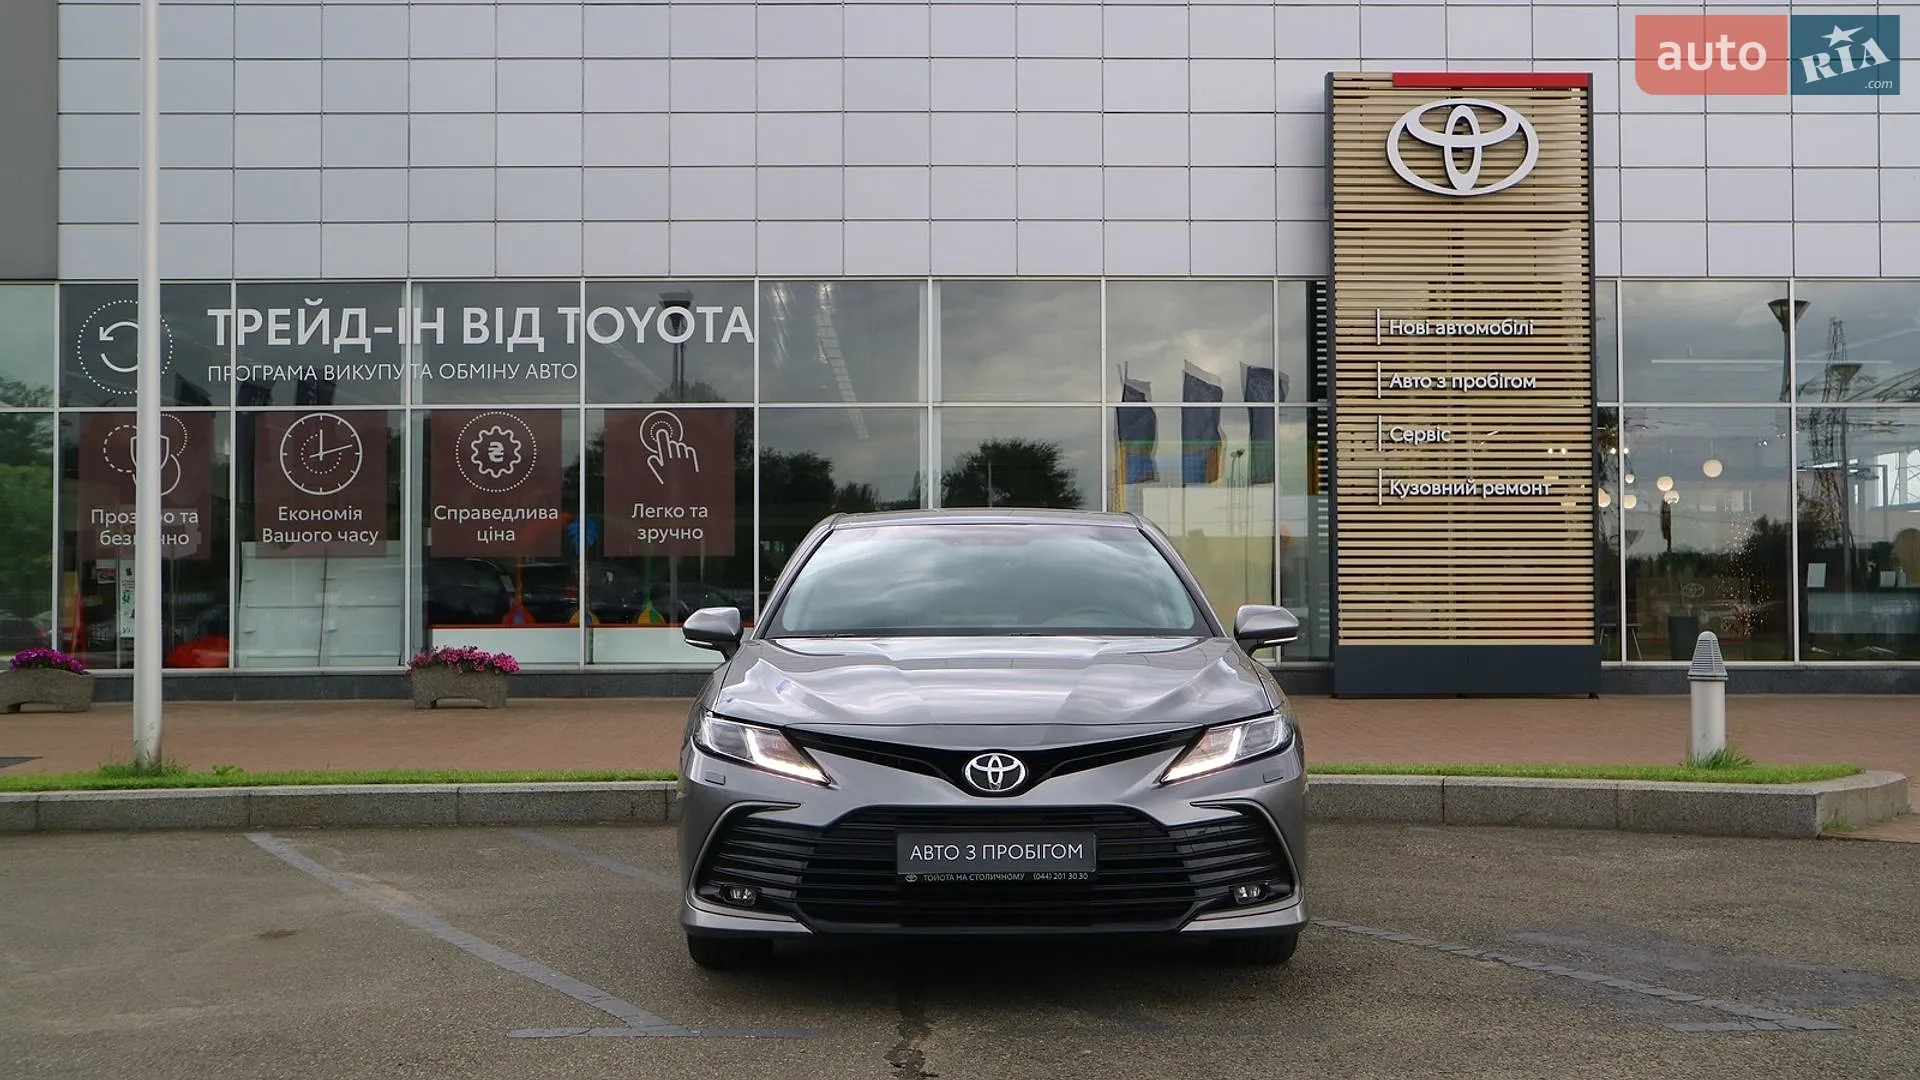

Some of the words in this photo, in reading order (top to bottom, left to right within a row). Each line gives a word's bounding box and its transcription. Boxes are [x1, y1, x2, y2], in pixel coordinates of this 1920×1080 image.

[207, 298, 445, 354] ТРЕЙД-ІН
[463, 307, 545, 352] ВІД
[557, 306, 754, 345] TOYOTA
[1389, 319, 1430, 335] Нові
[1435, 319, 1534, 336] автомобілі
[208, 364, 317, 382] ПРОГРАМА
[324, 363, 405, 381] ВИКУПУ
[409, 363, 433, 379] ТА
[439, 362, 520, 380] ОБМІНУ
[525, 363, 577, 380] АВТО
[1389, 373, 1432, 389] Авто
[1437, 377, 1446, 389] з
[1452, 372, 1537, 393] пробігом
[1389, 426, 1452, 445] Сервіс
[1390, 478, 1477, 500] Кузовний
[1483, 482, 1552, 499] ремонт
[91, 509, 174, 527] Прозо
[180, 512, 198, 524] та
[278, 505, 363, 521] Економія
[434, 505, 558, 523] Справедлива
[632, 503, 685, 519] Легко
[690, 507, 708, 518] та
[100, 530, 189, 545] безно
[262, 528, 332, 543] Вашого
[338, 530, 379, 545] часу
[477, 526, 515, 542] ціна
[637, 526, 703, 543] зручно
[910, 845, 959, 860] АВТО
[983, 844, 1083, 860] ПРОБІГОМ
[956, 872, 968, 881] НА
[969, 872, 1025, 881] СТОЛИЧНОМУ
[1053, 872, 1066, 880] 201
[1068, 872, 1078, 880] 30
[1079, 872, 1089, 880] 30
